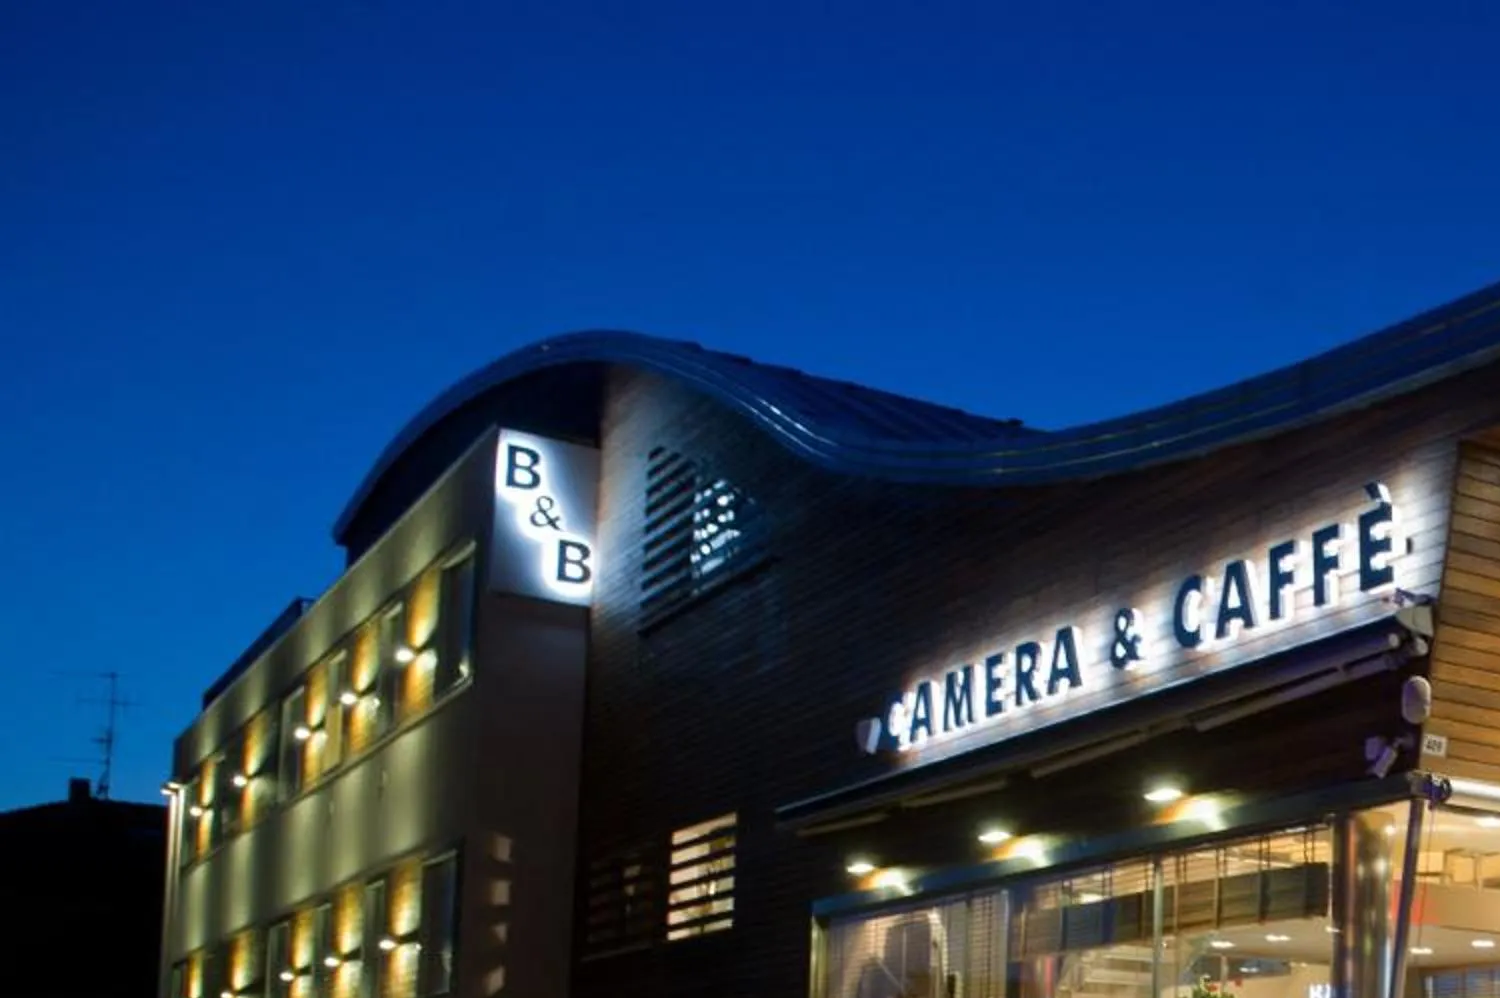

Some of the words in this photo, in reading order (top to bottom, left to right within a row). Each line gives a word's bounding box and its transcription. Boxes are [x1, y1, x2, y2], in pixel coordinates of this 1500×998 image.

[879, 625, 1083, 750] CAMERA
[1109, 606, 1144, 670] &
[1172, 480, 1394, 649] CAFFÈ
